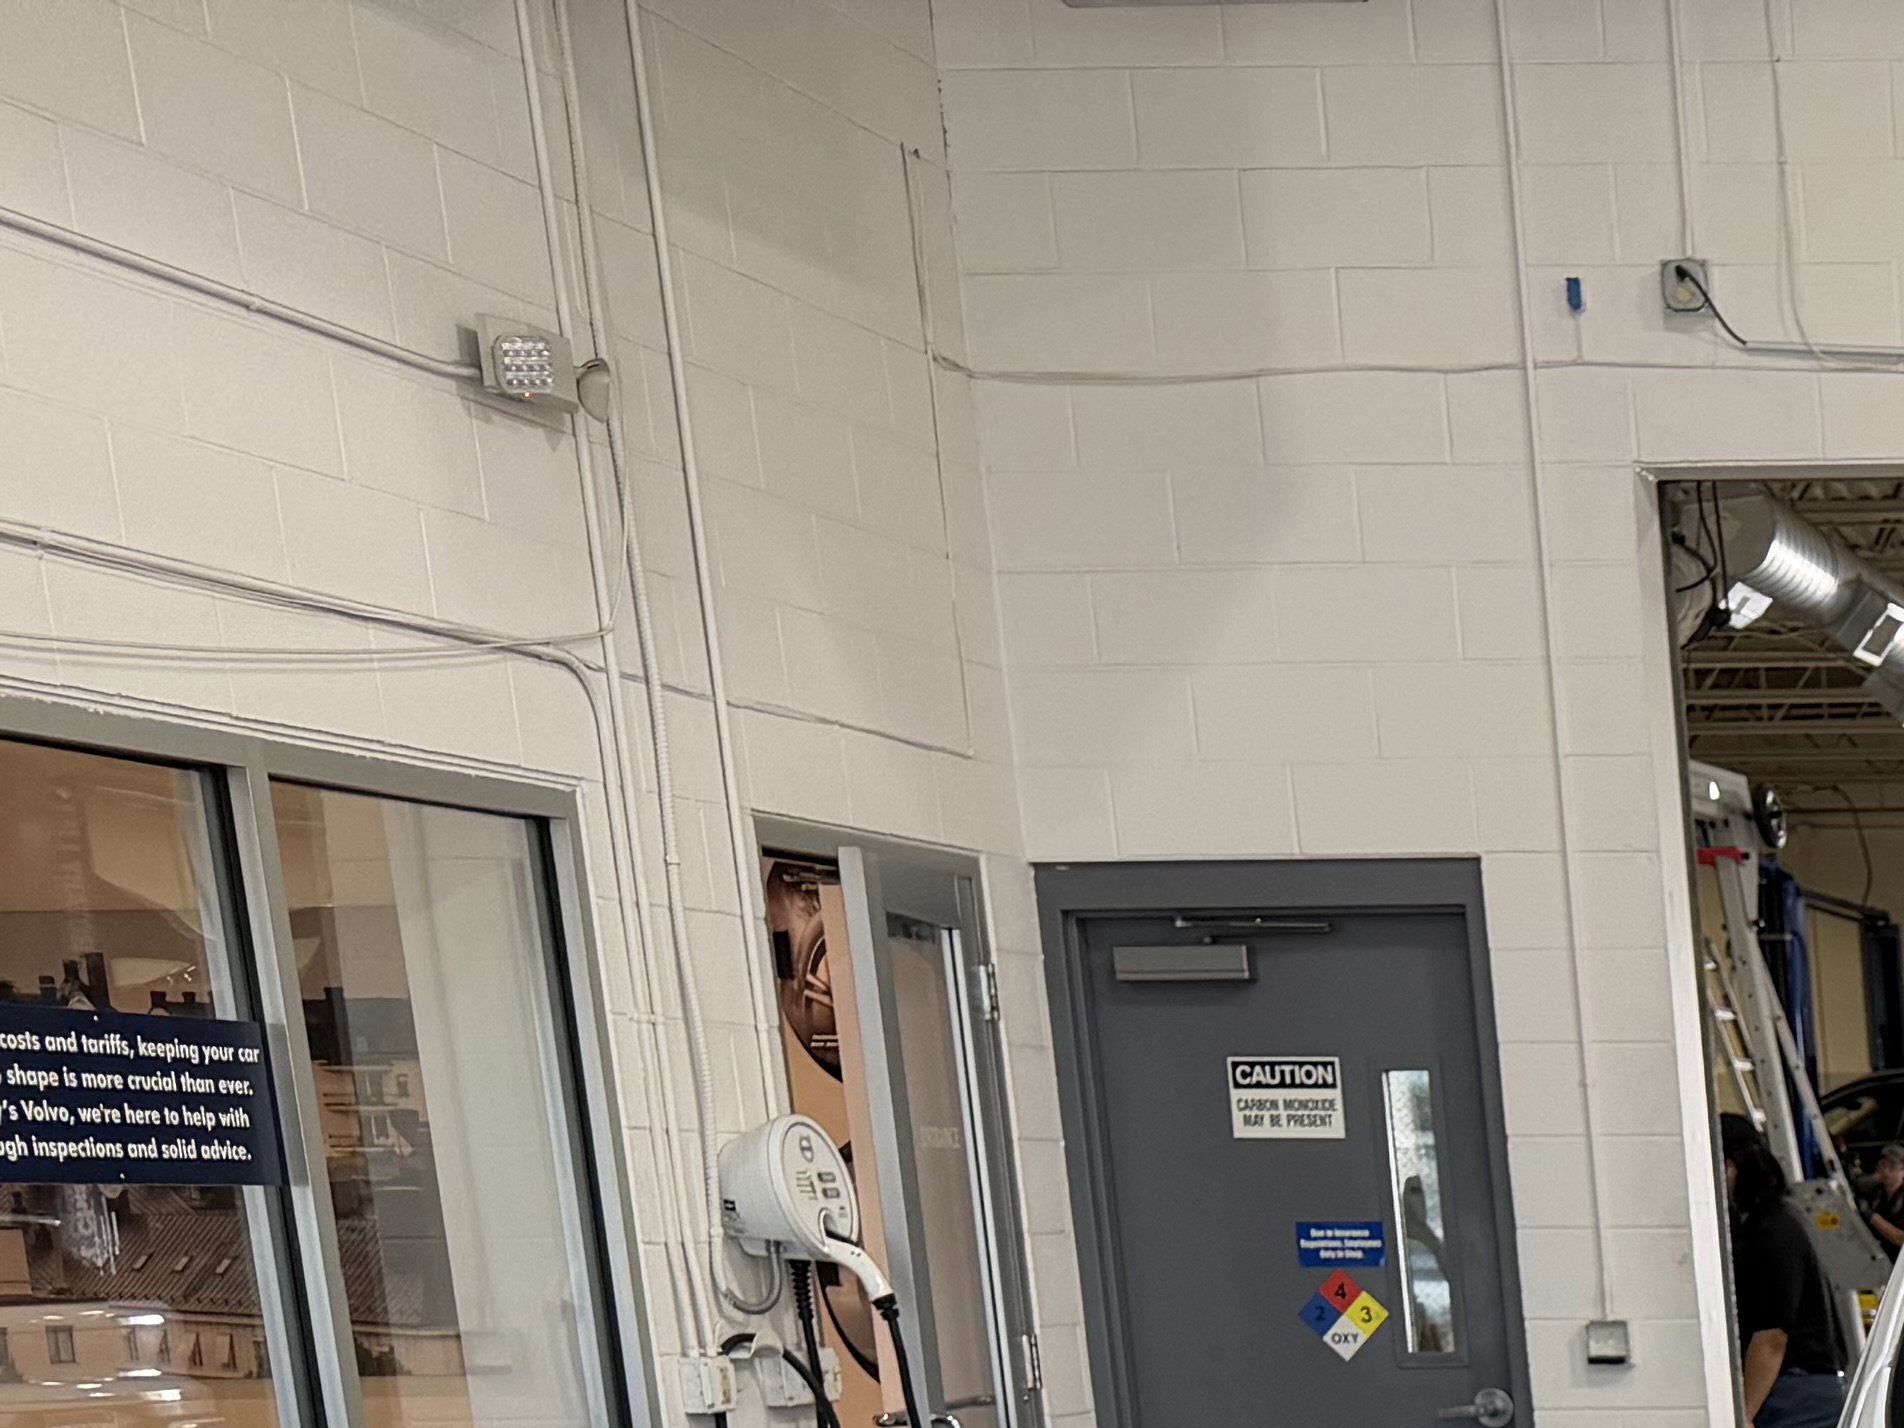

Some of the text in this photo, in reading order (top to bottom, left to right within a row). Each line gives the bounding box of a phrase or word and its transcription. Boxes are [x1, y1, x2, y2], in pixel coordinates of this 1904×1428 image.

[0, 1031, 260, 1065] costs and tariffs, keeping your car
[7, 1063, 254, 1096] shape is more crucial than ever.
[1235, 1064, 1334, 1085] CAUTION
[1237, 1098, 1337, 1112] CARBON MONOXIDE
[0, 1100, 250, 1132] 's Volvo, we're here to help with
[1243, 1114, 1332, 1127] MAY BE PRESENT
[32, 1135, 123, 1162] inspections
[128, 1137, 158, 1159] and
[162, 1138, 197, 1160] solid
[201, 1138, 252, 1161] advice.
[1334, 1283, 1347, 1299] 4
[1315, 1306, 1326, 1321] 2
[1360, 1306, 1373, 1323] 3
[1331, 1332, 1359, 1344] OXY
